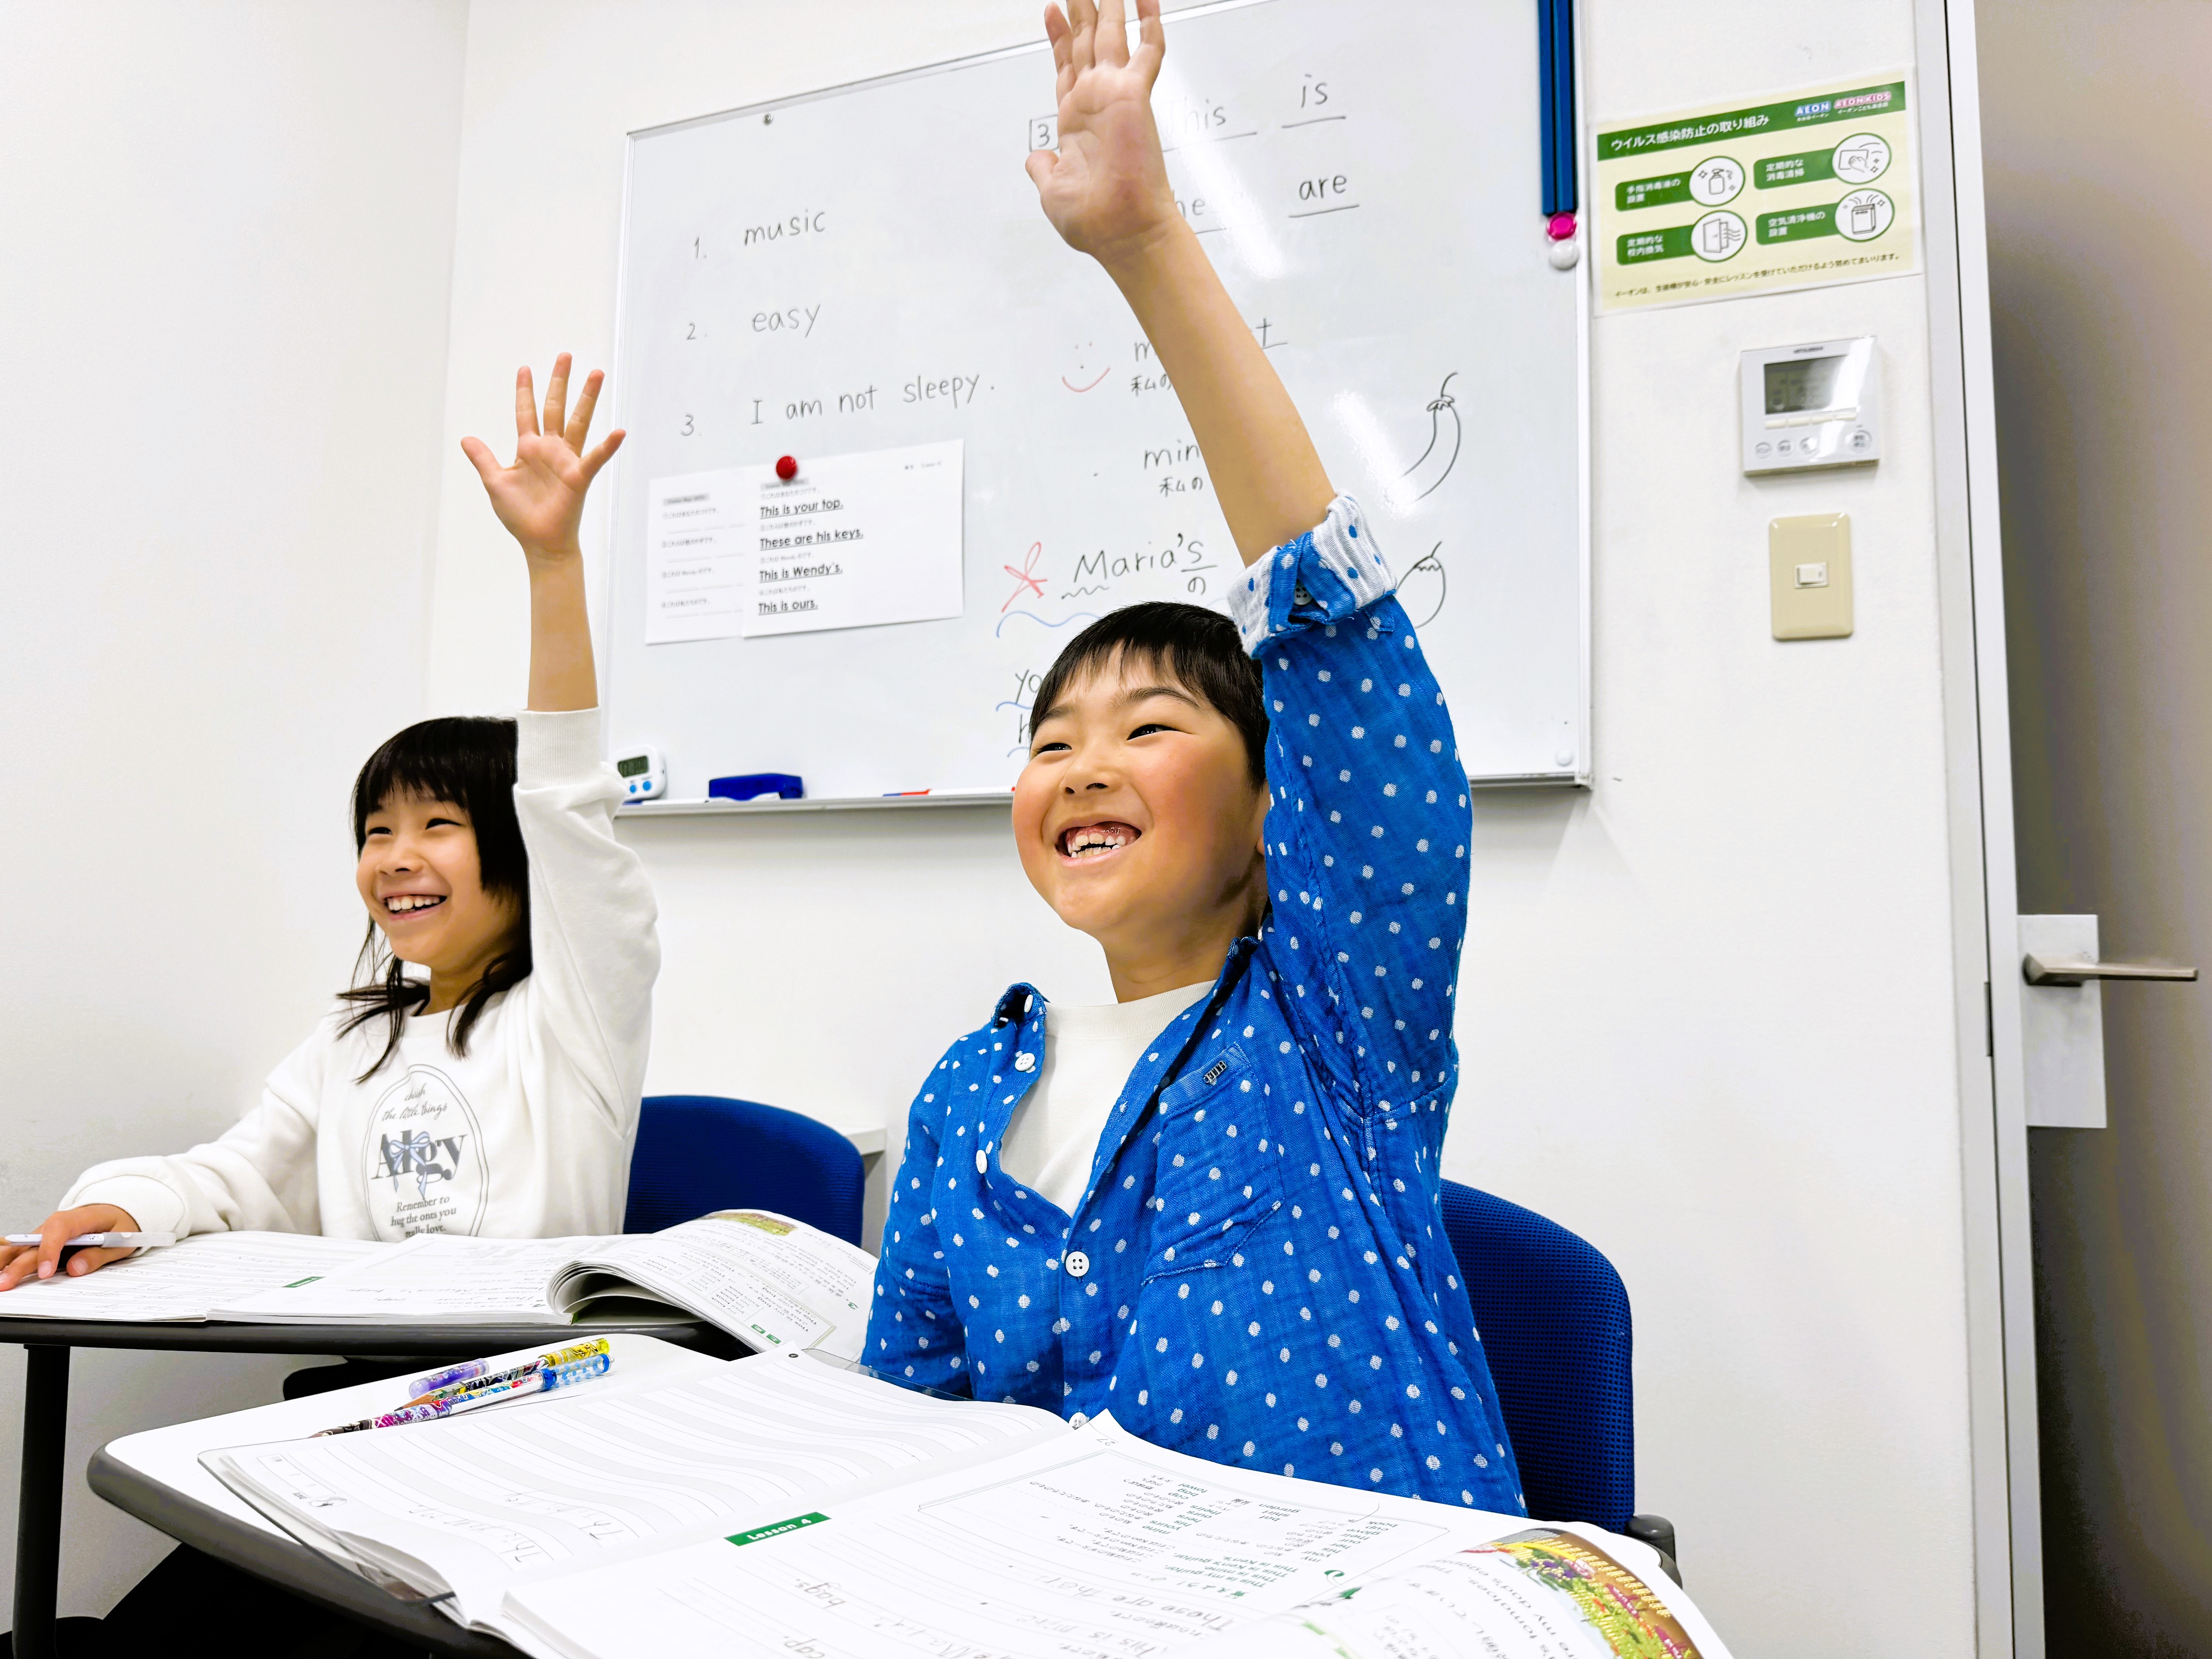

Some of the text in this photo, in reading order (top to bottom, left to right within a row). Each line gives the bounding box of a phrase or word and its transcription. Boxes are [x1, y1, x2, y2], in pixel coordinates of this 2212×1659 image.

[1301, 74, 1328, 108] is
[1836, 93, 1890, 107] AEON KIDS
[1796, 102, 1829, 115] AEON
[1038, 124, 1050, 147] 3
[1611, 114, 1769, 151] ウイルス感染防止の取り組み
[1765, 159, 1803, 172] 定期的な
[1299, 175, 1347, 200] are
[694, 209, 825, 259] 1. music
[752, 304, 820, 338] easy
[751, 400, 763, 425] I
[786, 400, 822, 419] am
[839, 385, 877, 412] not
[903, 374, 994, 409] sleepy.
[1144, 438, 1200, 470] min
[1159, 476, 1203, 497] 私の
[760, 499, 843, 518] This is your top.
[760, 528, 864, 549] These are his keys.
[1074, 532, 1204, 583] Maria's
[760, 563, 843, 581] This is Wendy's.
[1187, 577, 1206, 595] の
[759, 600, 818, 614] This is ours.
[382, 1108, 397, 1121] the
[420, 1102, 448, 1120] things
[397, 1196, 450, 1212] Remember to
[391, 1207, 457, 1228] hug the ones you
[426, 1224, 447, 1235] love.
[778, 1299, 793, 1308] your
[795, 1322, 808, 1332] This
[804, 1314, 816, 1325] This
[1178, 1484, 1207, 1493] towel
[1190, 1506, 1221, 1515] theirs
[1259, 1504, 1300, 1513] garden
[746, 1517, 812, 1541] Lesson 4
[1142, 1526, 1171, 1534] mine
[1150, 1521, 1182, 1530] yours
[1174, 1553, 1213, 1563] guitar.
[1165, 1565, 1204, 1574] guitar.
[1468, 1577, 1537, 1640] tomatoes.
